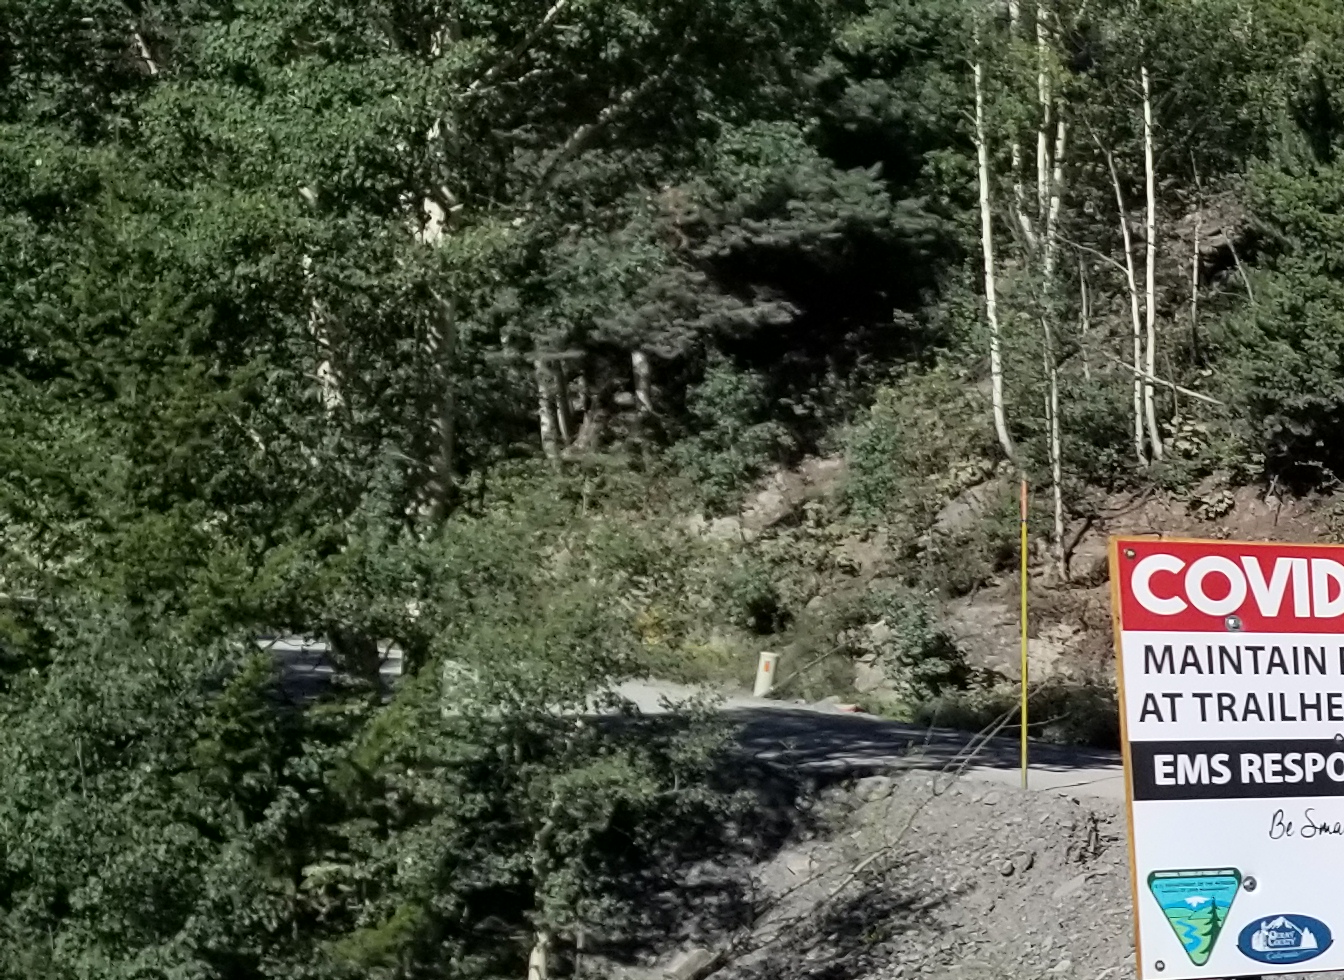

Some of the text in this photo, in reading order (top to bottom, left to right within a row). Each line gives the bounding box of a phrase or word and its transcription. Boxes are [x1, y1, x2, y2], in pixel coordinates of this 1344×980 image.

[1144, 644, 1327, 676] MAINTAIN
[1139, 692, 1184, 723] AT
[1153, 754, 1232, 786] EMS
[1269, 808, 1294, 840] Be
